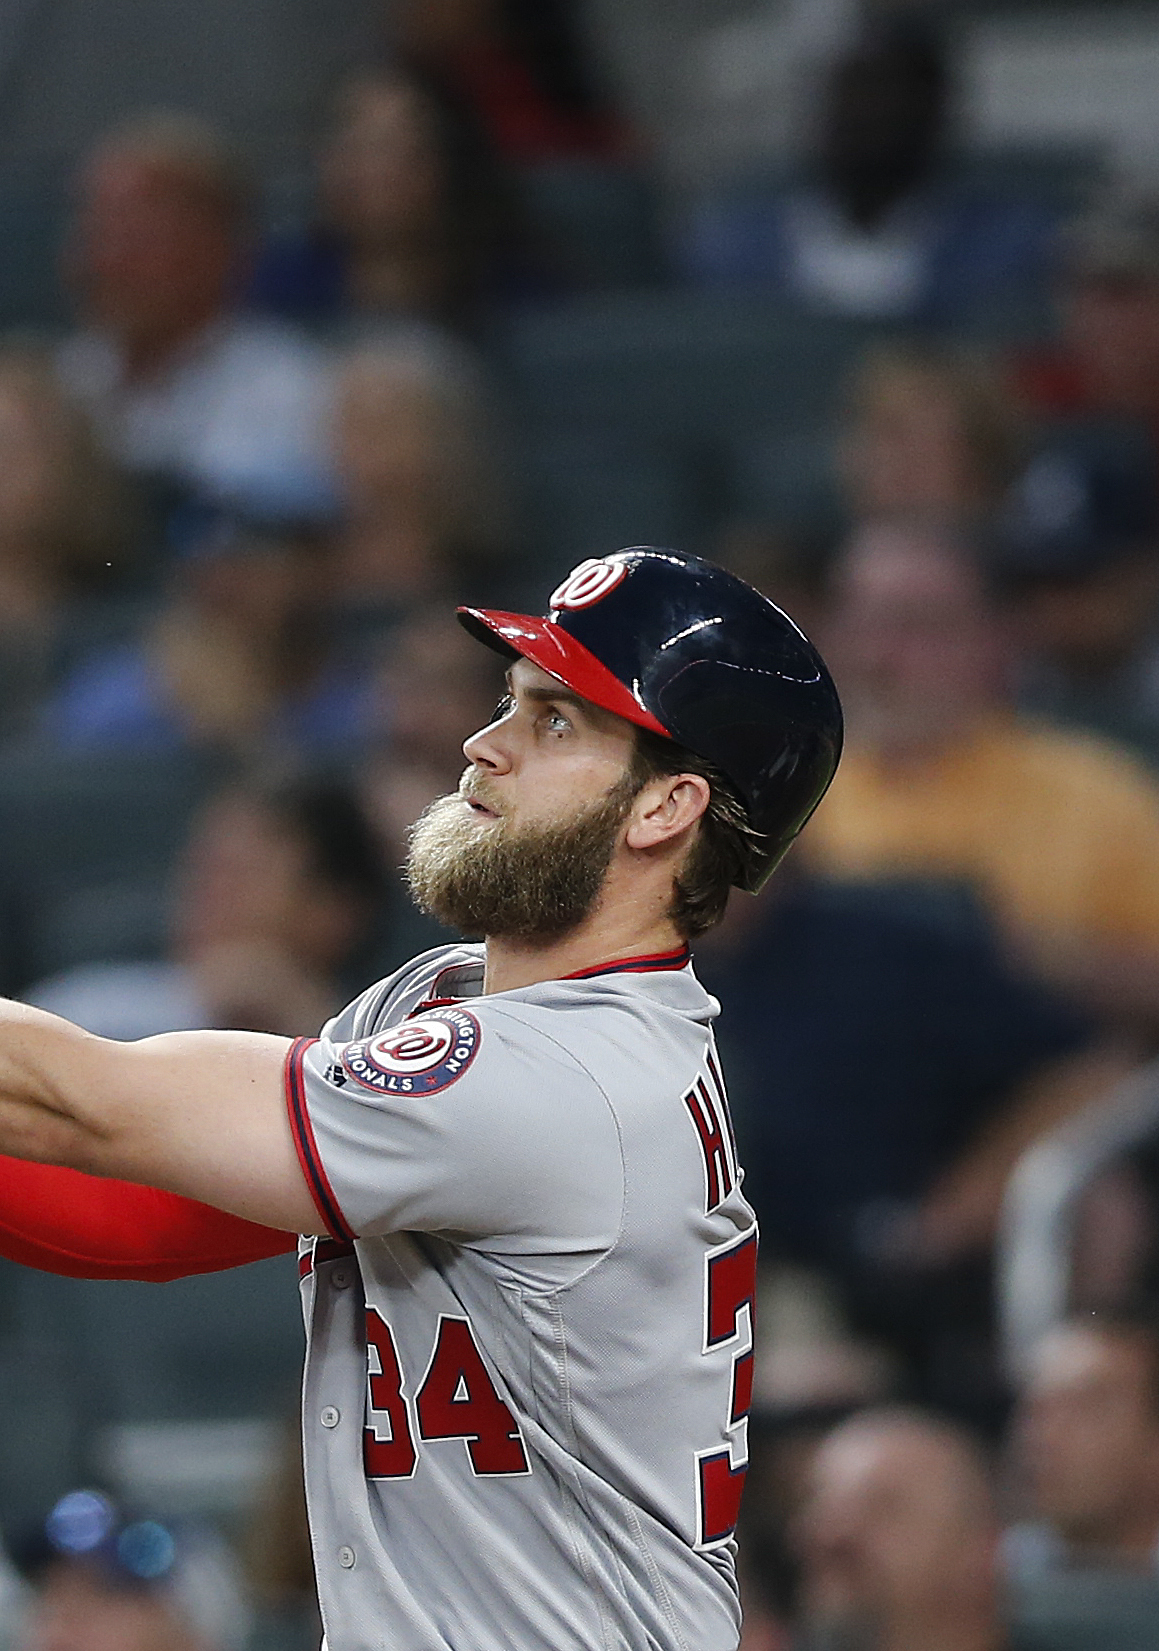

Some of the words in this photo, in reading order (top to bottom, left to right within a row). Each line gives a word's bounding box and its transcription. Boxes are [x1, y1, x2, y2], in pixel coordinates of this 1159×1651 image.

[347, 1043, 413, 1091] TIONALS
[417, 1009, 475, 1074] SHINGTON
[364, 1303, 533, 1480] 34
